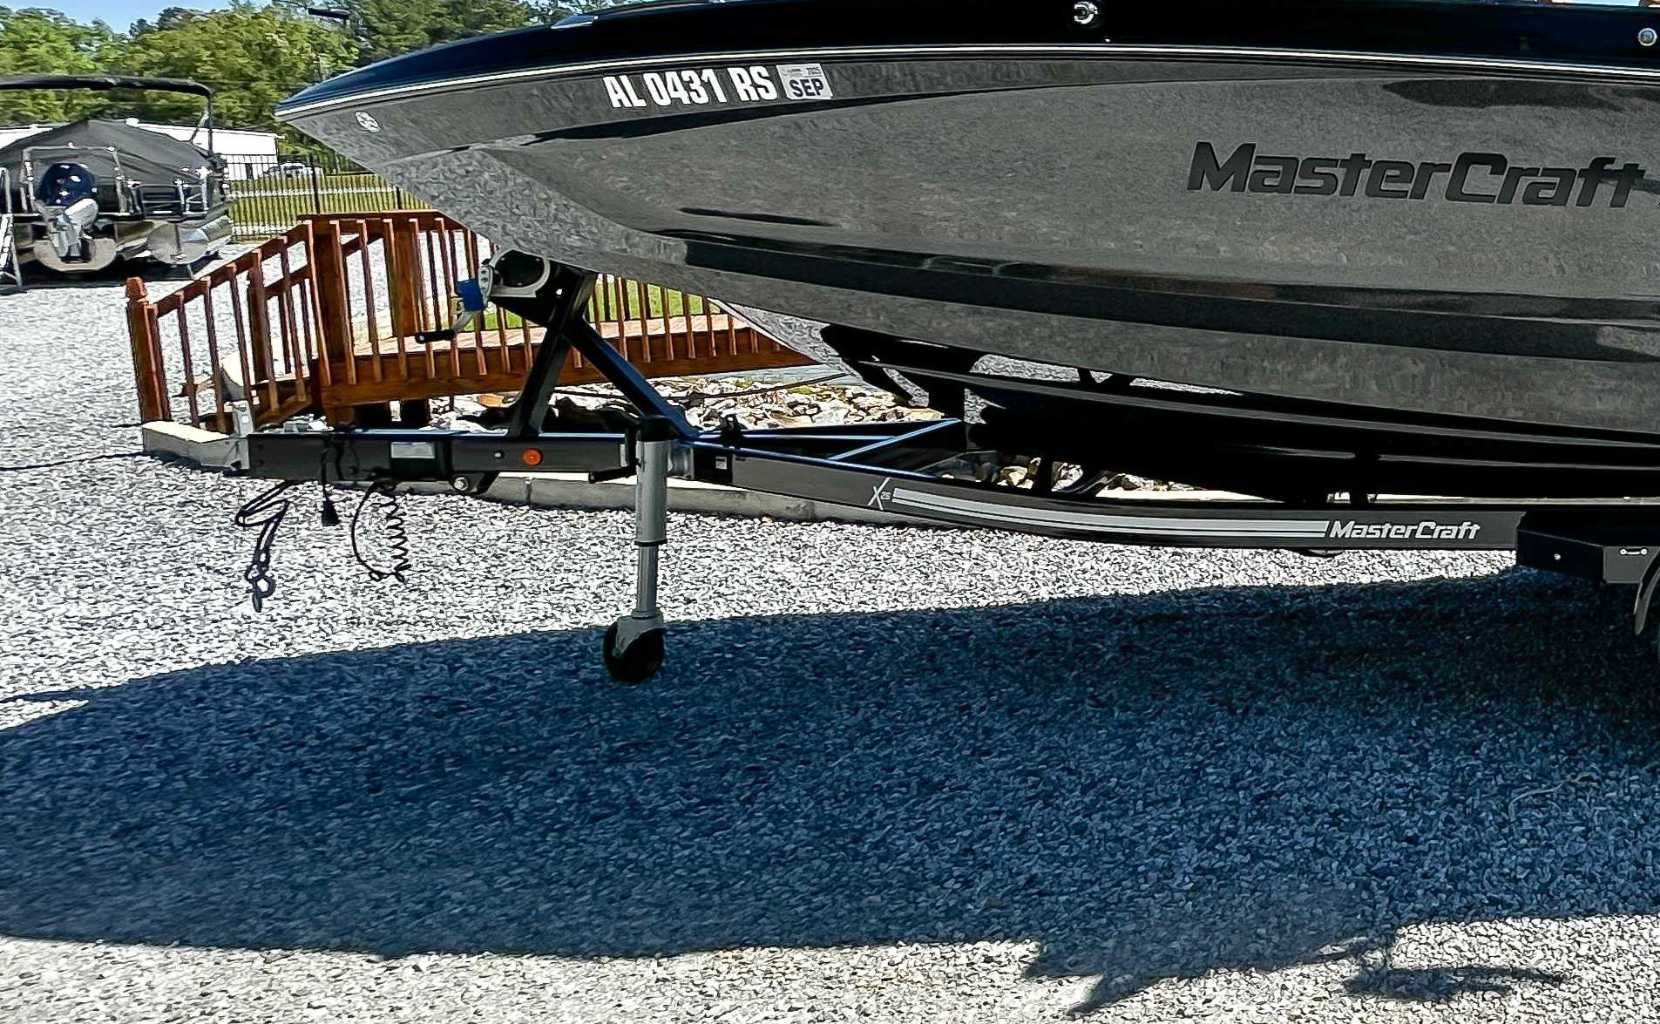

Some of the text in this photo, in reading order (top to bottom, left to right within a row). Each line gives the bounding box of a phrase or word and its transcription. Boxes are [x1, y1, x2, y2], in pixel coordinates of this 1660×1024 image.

[602, 65, 778, 108] AL 0431 RS
[789, 78, 824, 97] SEP
[1186, 141, 1646, 208] MasterCraft
[1329, 520, 1480, 539] MasterCraft
